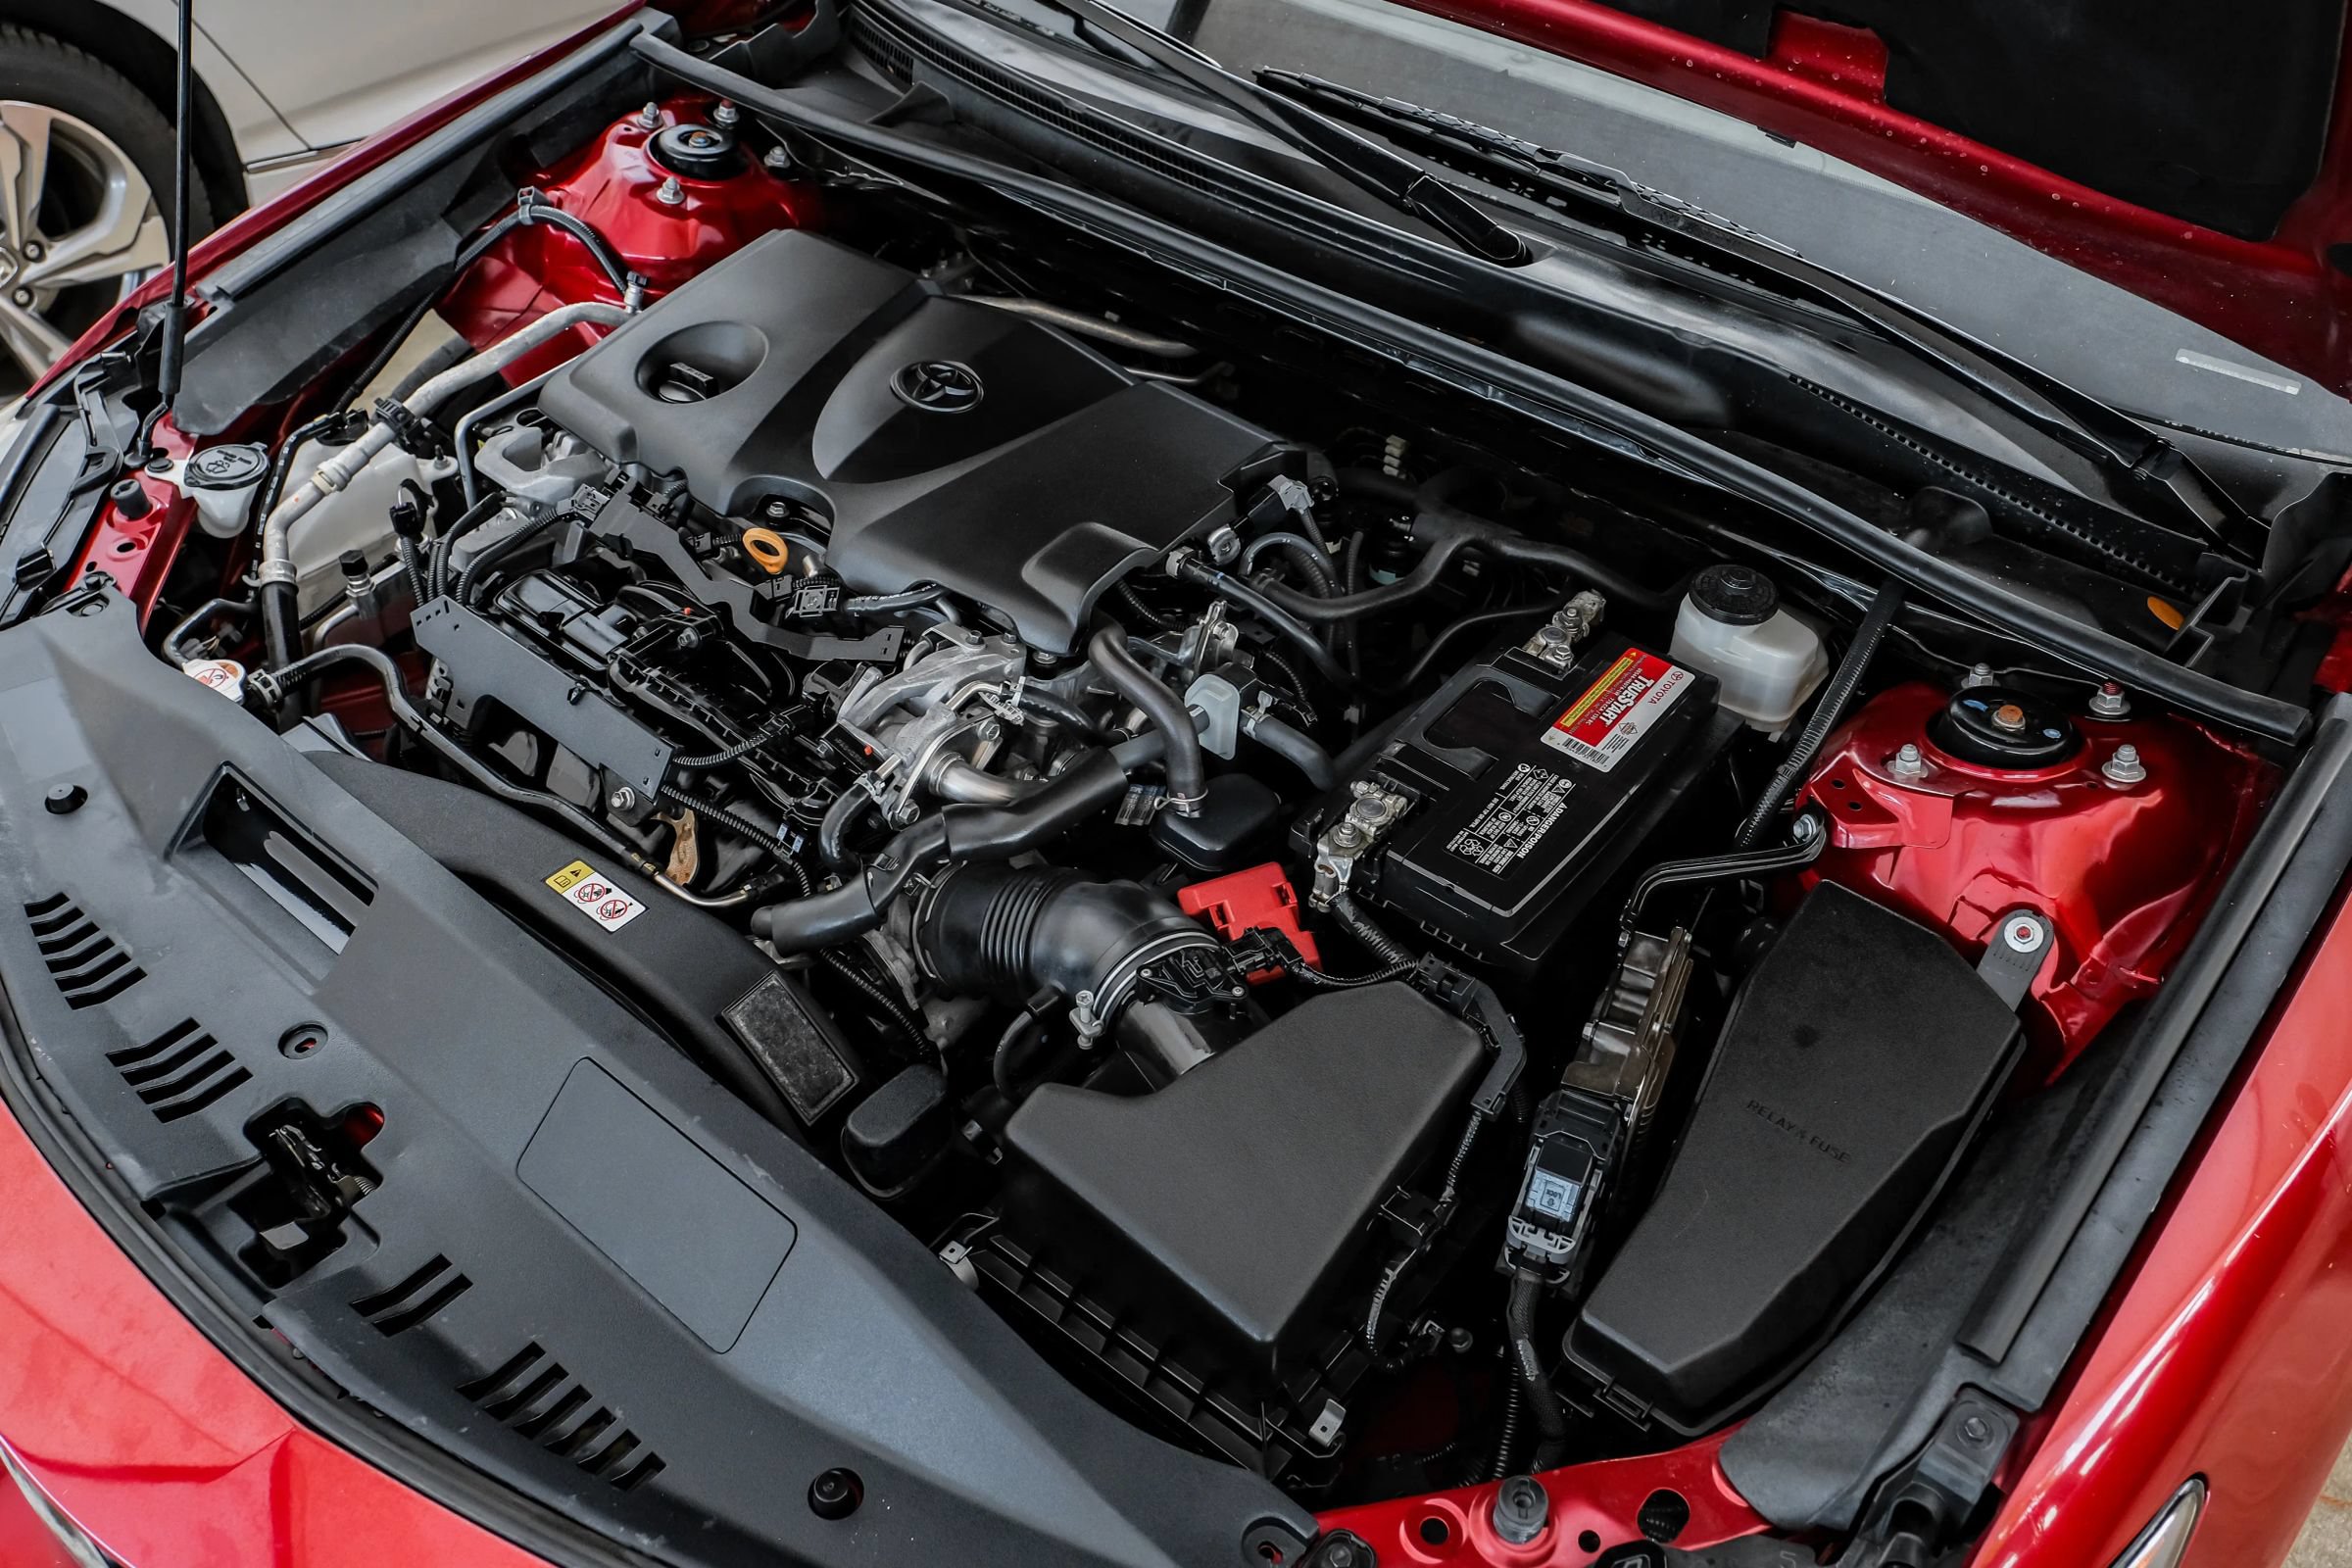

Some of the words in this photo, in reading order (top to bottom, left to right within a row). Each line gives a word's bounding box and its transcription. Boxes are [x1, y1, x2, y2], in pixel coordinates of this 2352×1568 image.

[1648, 680, 1675, 706] TOYOTA
[1516, 808, 1564, 858] DANGER/POISON
[1745, 1100, 1796, 1132] RELAY
[1809, 1135, 1851, 1162] FUSE
